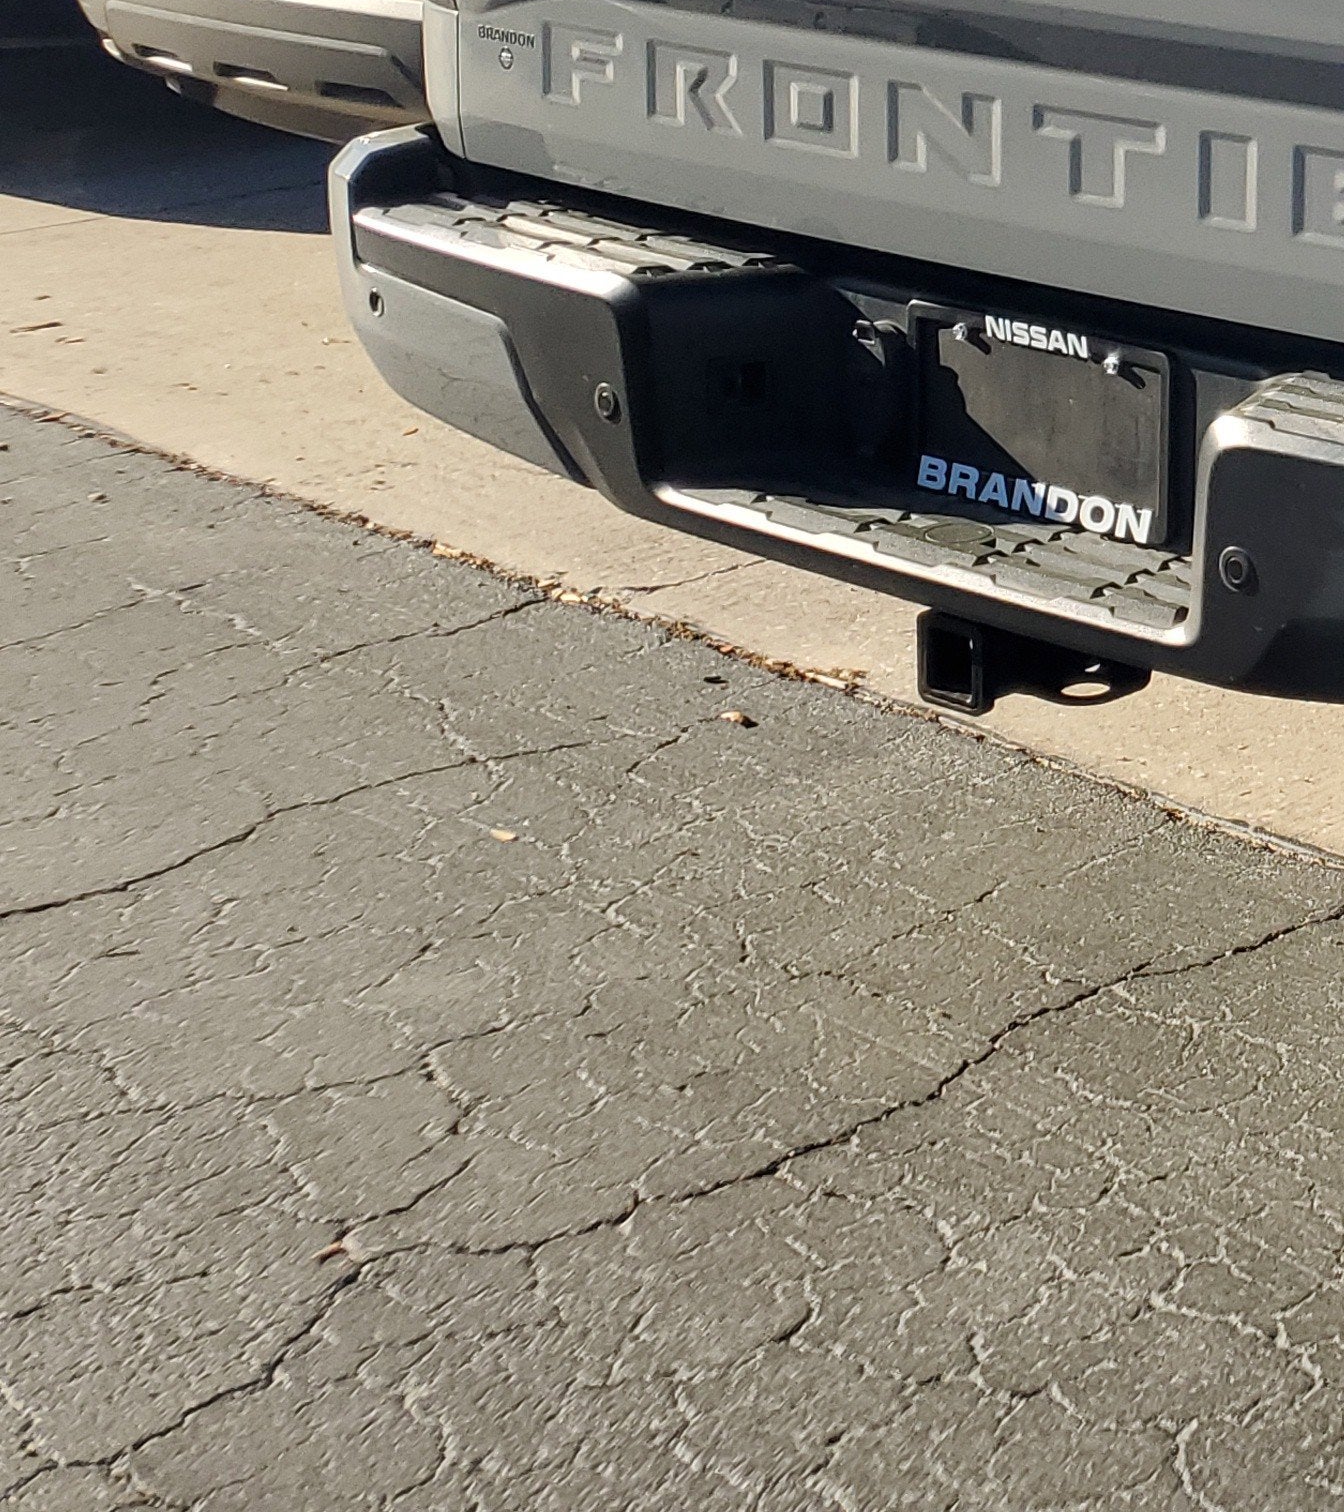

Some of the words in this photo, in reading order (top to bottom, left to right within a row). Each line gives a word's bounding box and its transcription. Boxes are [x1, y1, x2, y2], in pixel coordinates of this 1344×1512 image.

[477, 24, 536, 49] BRANDON
[984, 314, 1089, 360] NISSAN
[916, 454, 1154, 545] BRANDON
